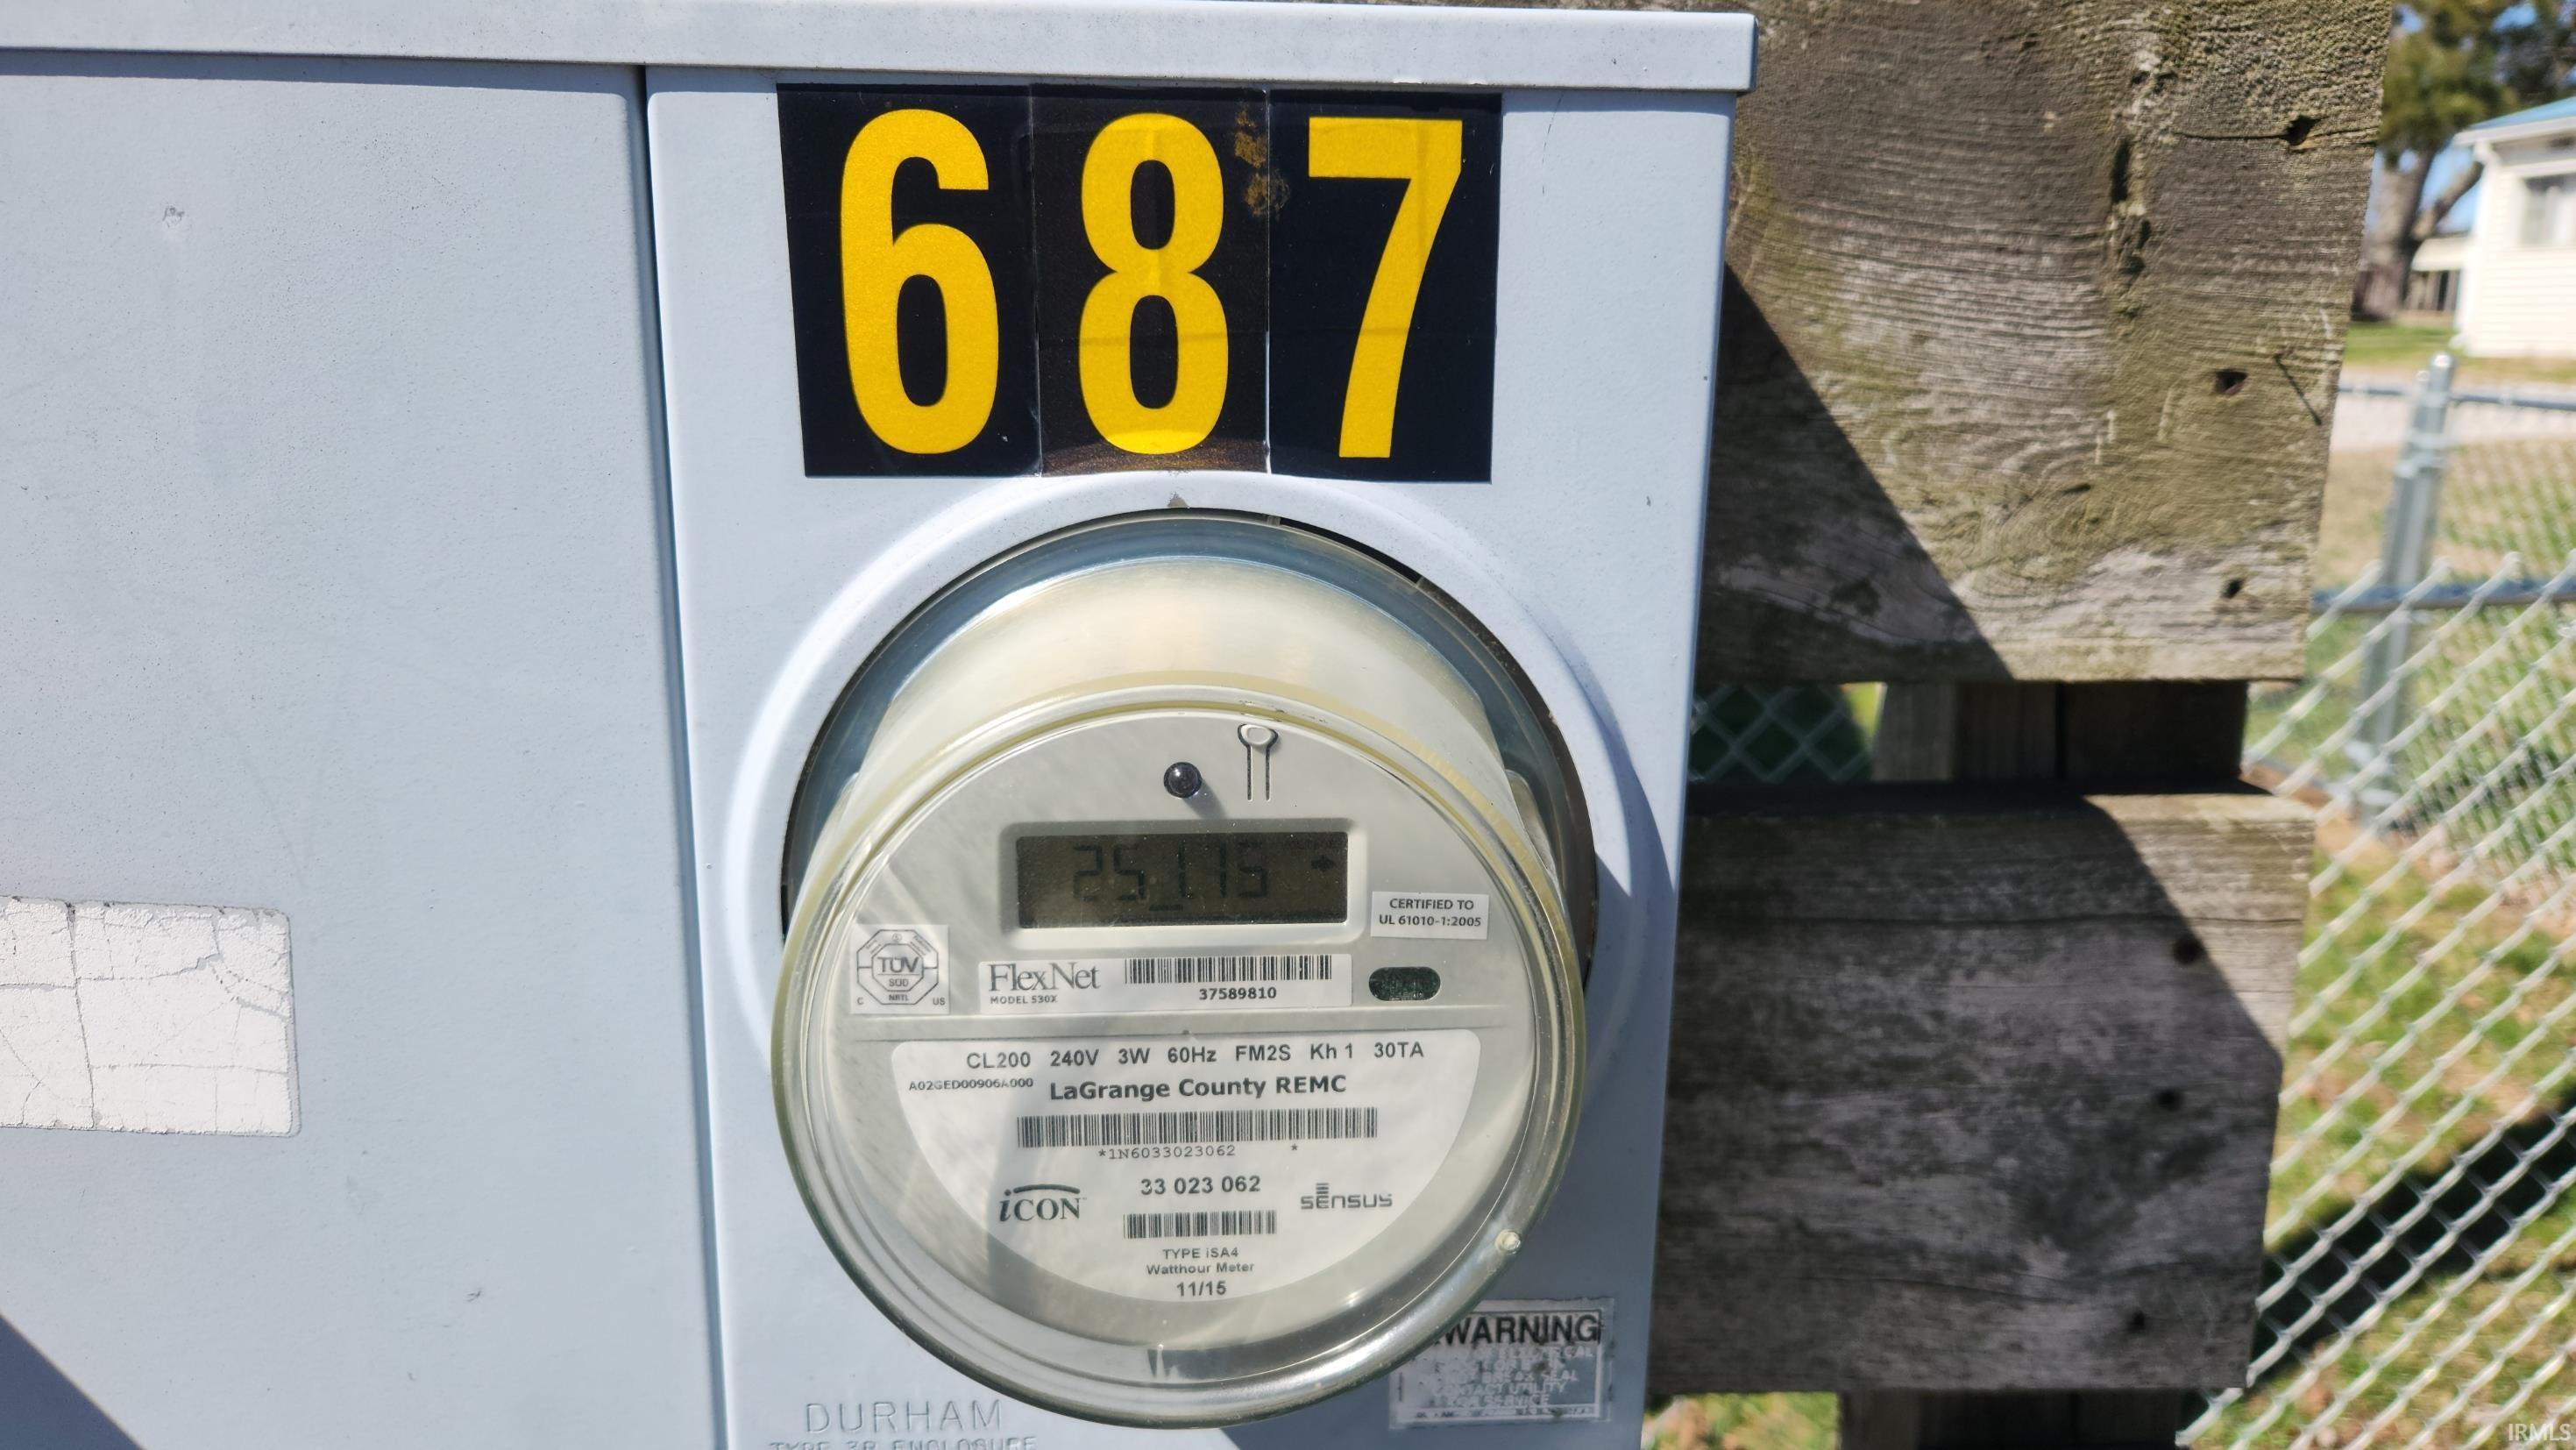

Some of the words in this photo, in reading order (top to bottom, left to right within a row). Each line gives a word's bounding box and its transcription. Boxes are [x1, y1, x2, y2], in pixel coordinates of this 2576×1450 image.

[841, 109, 1462, 458] 687
[1389, 899, 1453, 910] CERTIFIED
[1457, 899, 1474, 910] TO
[1379, 914, 1395, 925] UL
[1398, 915, 1481, 927] 61010-1:2005
[989, 962, 1101, 992] FlexNet
[990, 996, 1028, 1005] MODEL
[1199, 987, 1277, 1000] 37589810
[967, 1052, 1032, 1069] CL200
[1050, 1049, 1099, 1067] 240V
[1118, 1048, 1150, 1064] 3W
[1167, 1047, 1217, 1063] 60Hz
[1235, 1044, 1291, 1062] FM2S
[1310, 1043, 1338, 1060] Kh
[1345, 1043, 1353, 1059] 1
[1373, 1042, 1424, 1058] 30TA
[1050, 1081, 1170, 1102] LaGrange
[1179, 1077, 1267, 1098] County
[1275, 1075, 1346, 1094] REMC
[1140, 1178, 1166, 1195] 33
[1174, 1176, 1214, 1194] 023
[1221, 1175, 1261, 1193] 062
[1162, 1248, 1201, 1260] TYPE
[1206, 1247, 1239, 1258] iSA4
[1146, 1263, 1211, 1275] Watthour
[1216, 1262, 1254, 1273] Meter
[1176, 1280, 1227, 1297] 11/15
[1444, 1314, 1600, 1345] WARNING
[805, 1399, 1002, 1434] DURHAM
